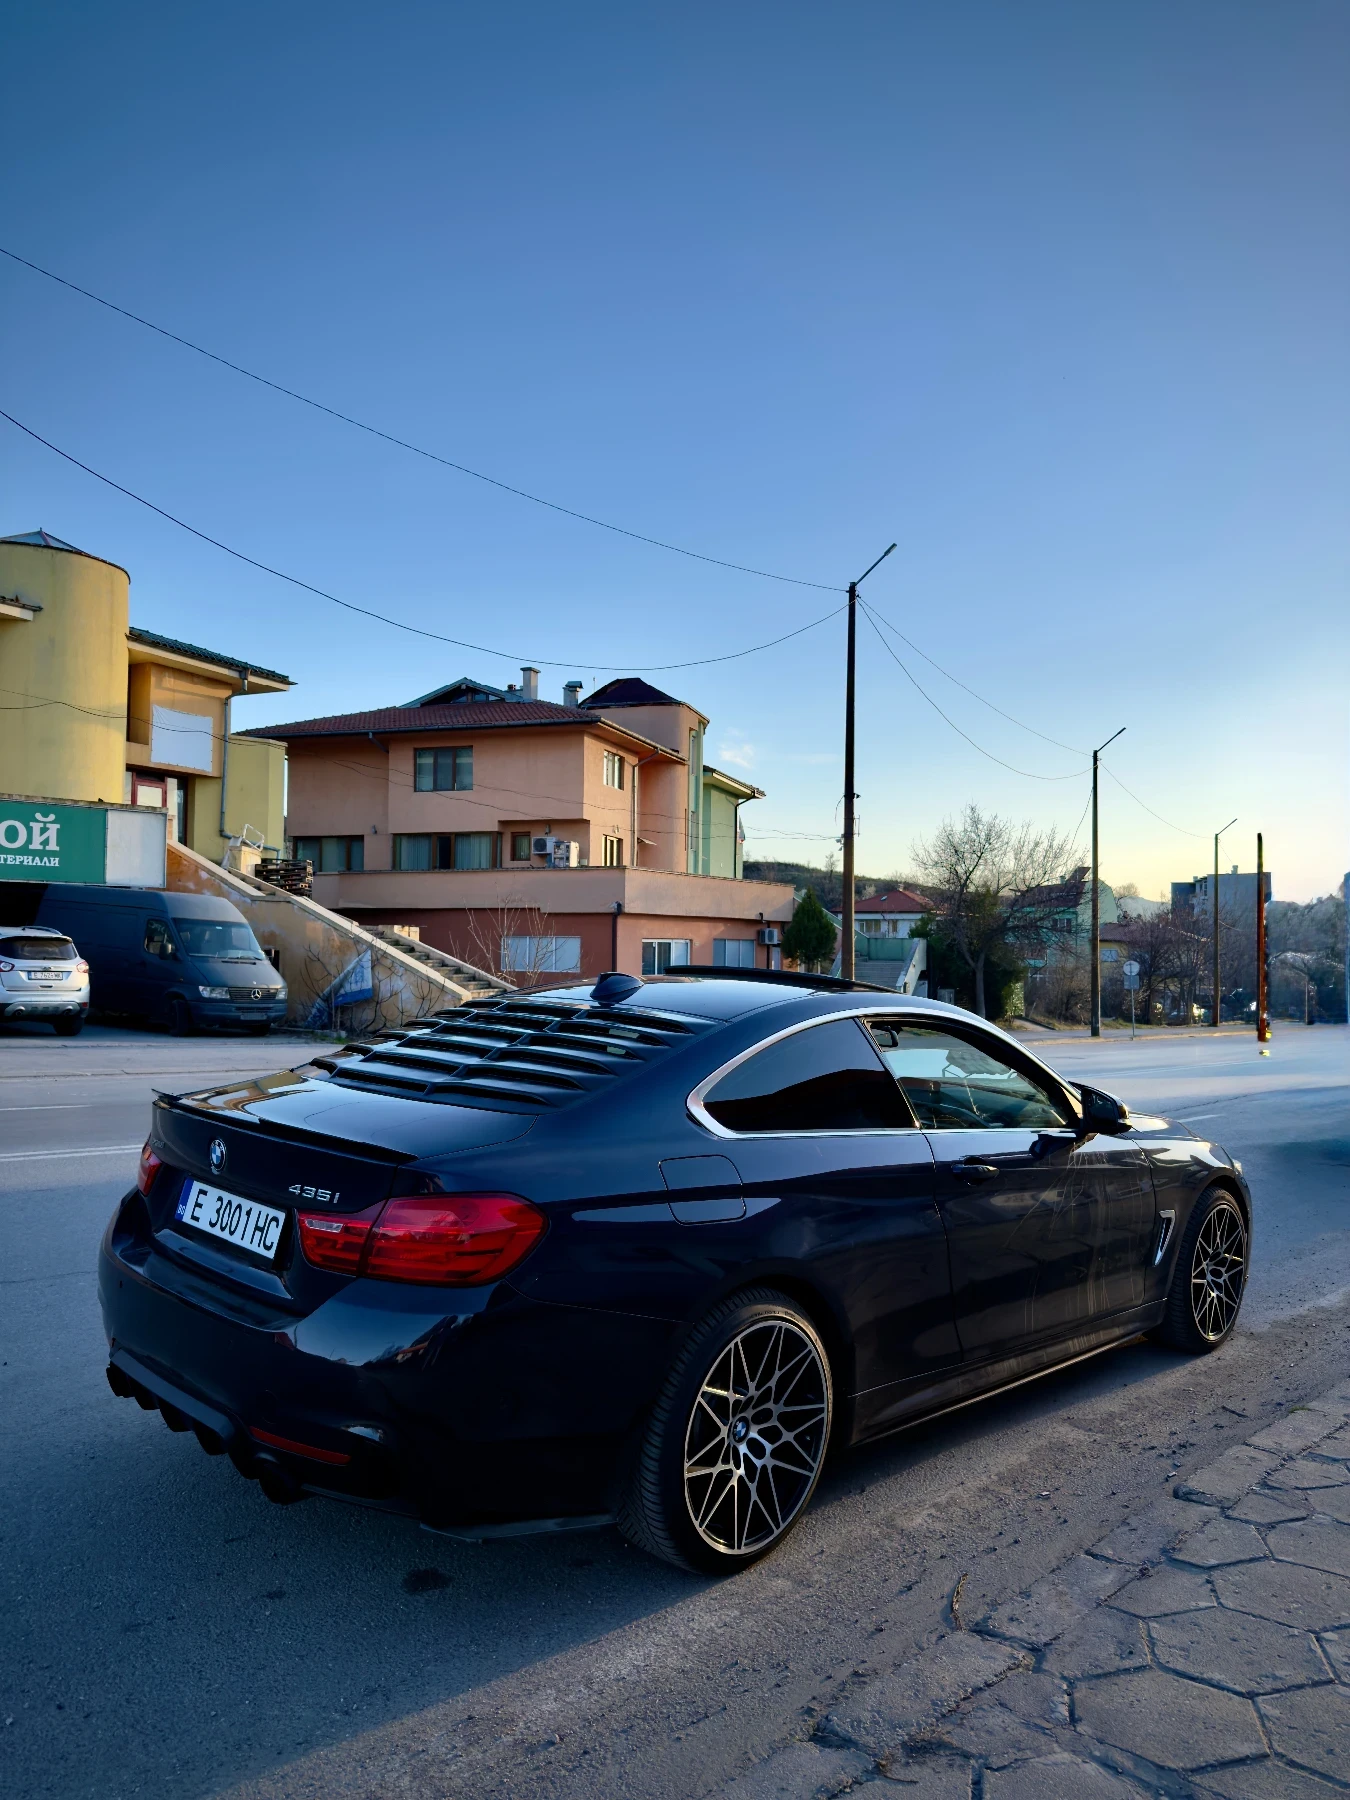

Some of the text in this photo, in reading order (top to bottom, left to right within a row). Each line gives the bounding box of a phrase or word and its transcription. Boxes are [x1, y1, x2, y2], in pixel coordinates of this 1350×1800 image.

[0, 812, 61, 851] ОЙ
[0, 854, 60, 867] ТЕРИАЛИ
[190, 1188, 208, 1223] E
